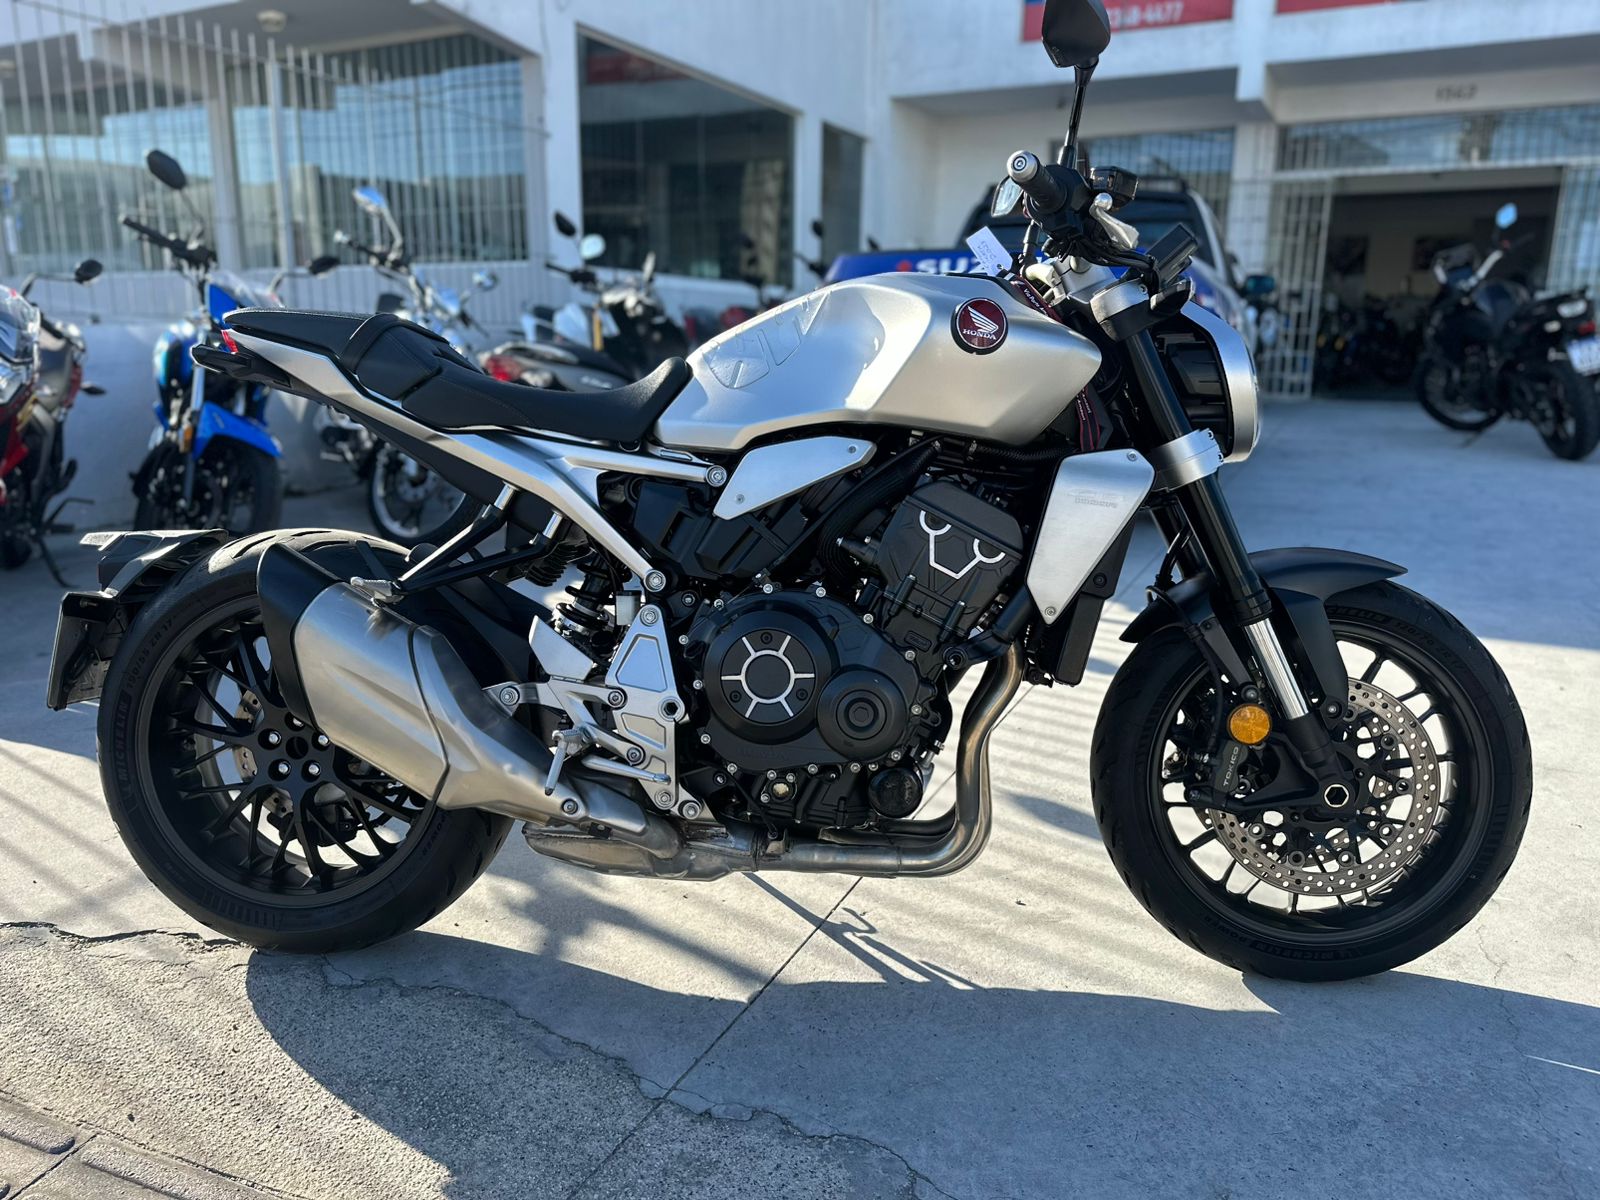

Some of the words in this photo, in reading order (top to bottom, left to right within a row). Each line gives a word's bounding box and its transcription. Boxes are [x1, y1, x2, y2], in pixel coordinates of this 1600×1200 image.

[915, 257, 990, 274] SUZ
[962, 328, 997, 340] HONDA
[1223, 746, 1239, 786] TOKICO
